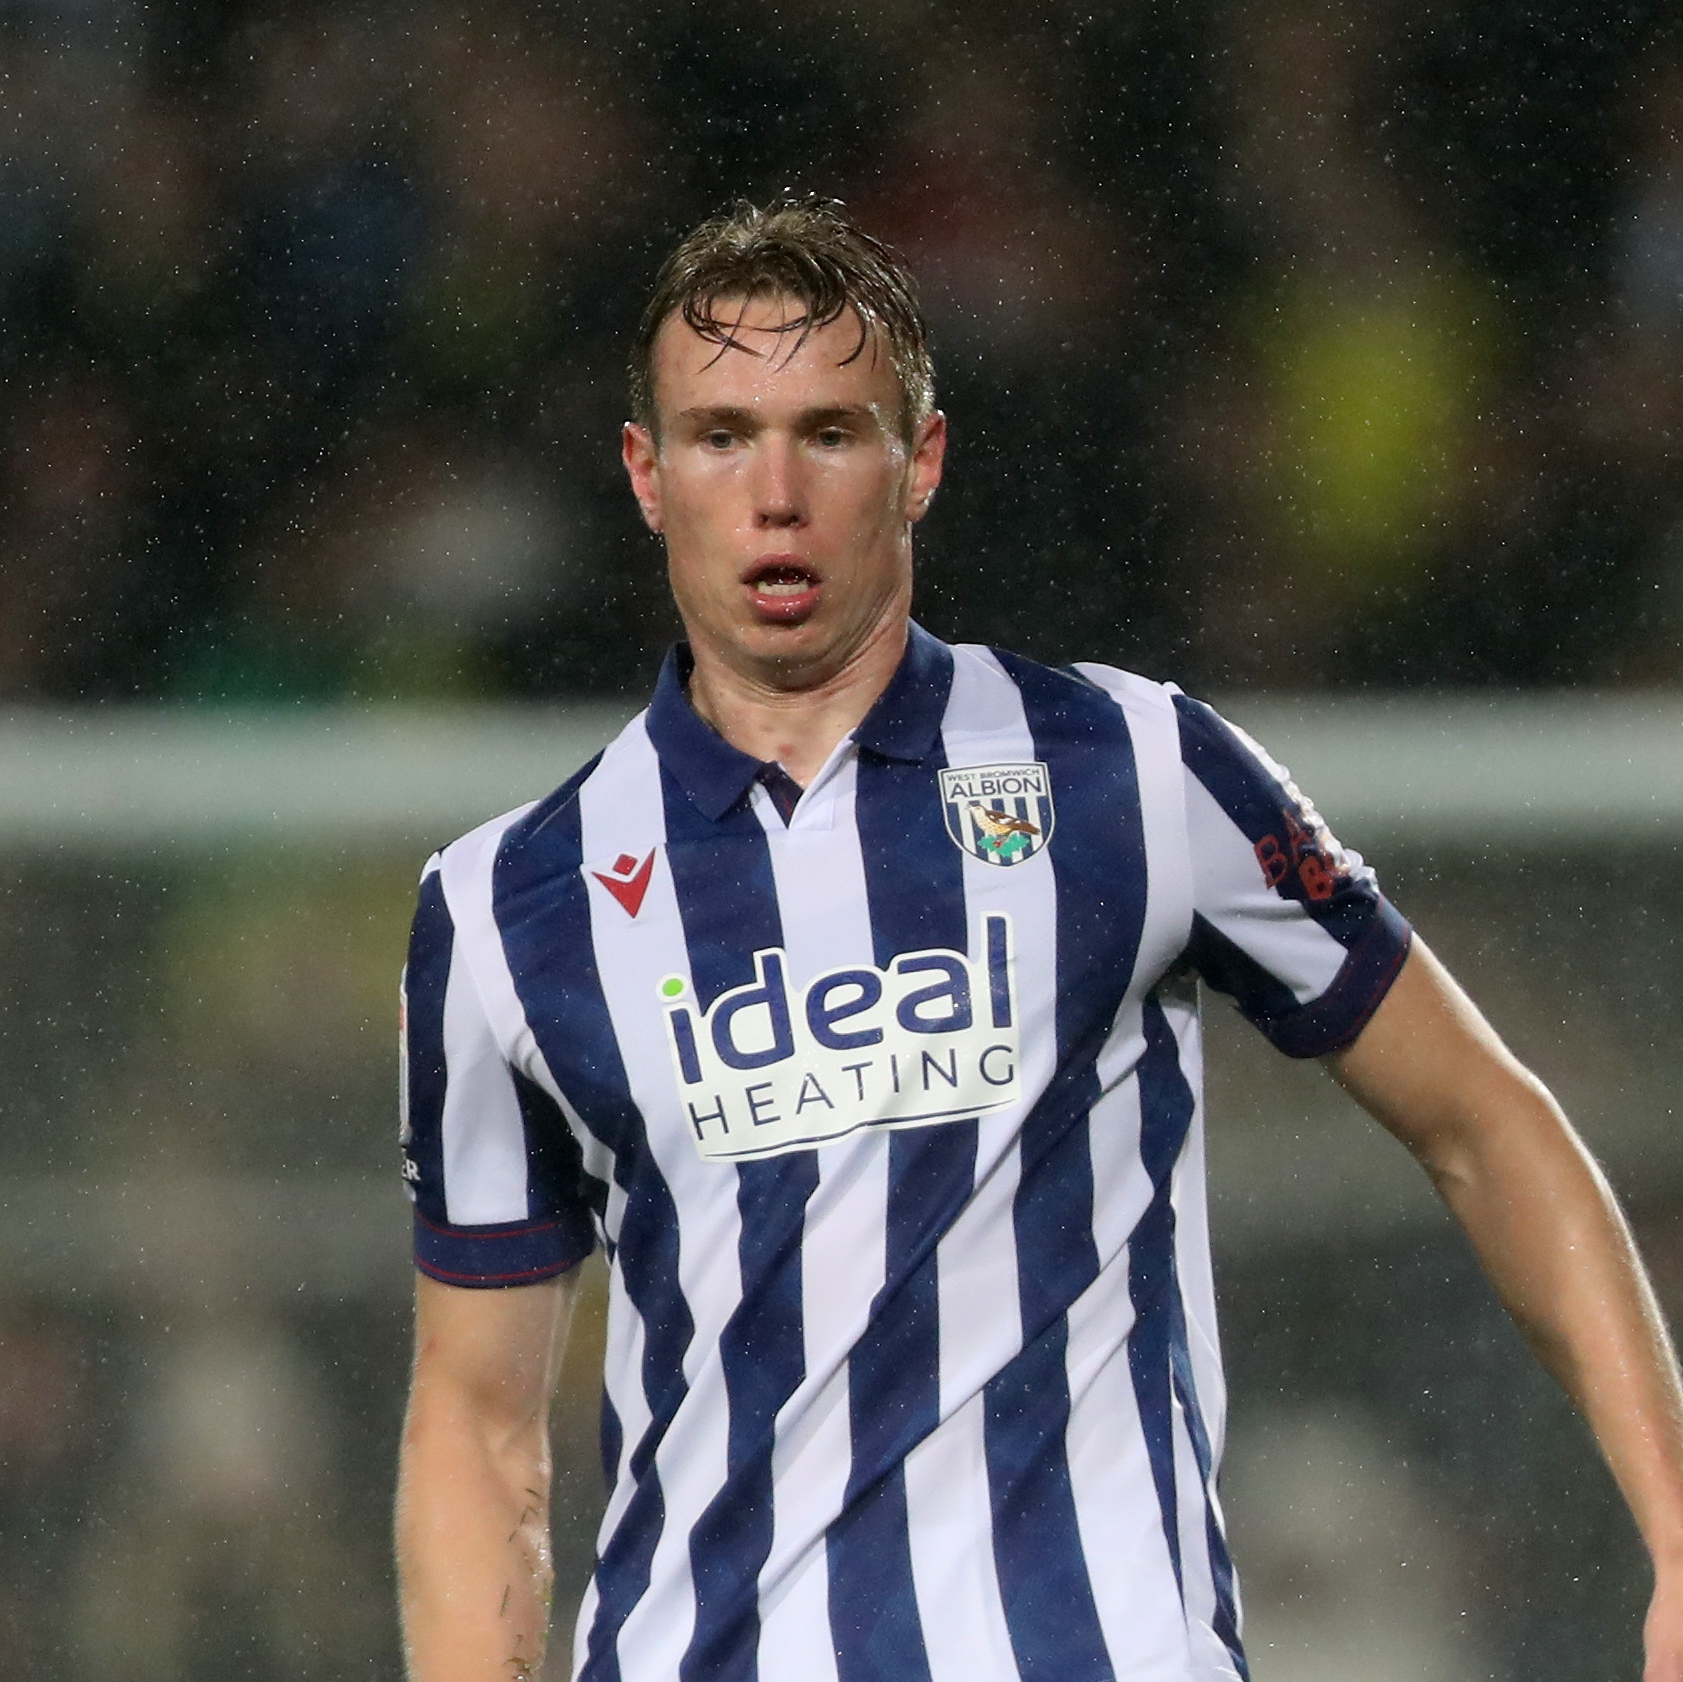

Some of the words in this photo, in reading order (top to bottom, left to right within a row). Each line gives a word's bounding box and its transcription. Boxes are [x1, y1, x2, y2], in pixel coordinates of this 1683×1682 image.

[950, 777, 1041, 798] ALBION
[661, 915, 1012, 1085] ideal
[688, 1044, 1015, 1141] HEATING
